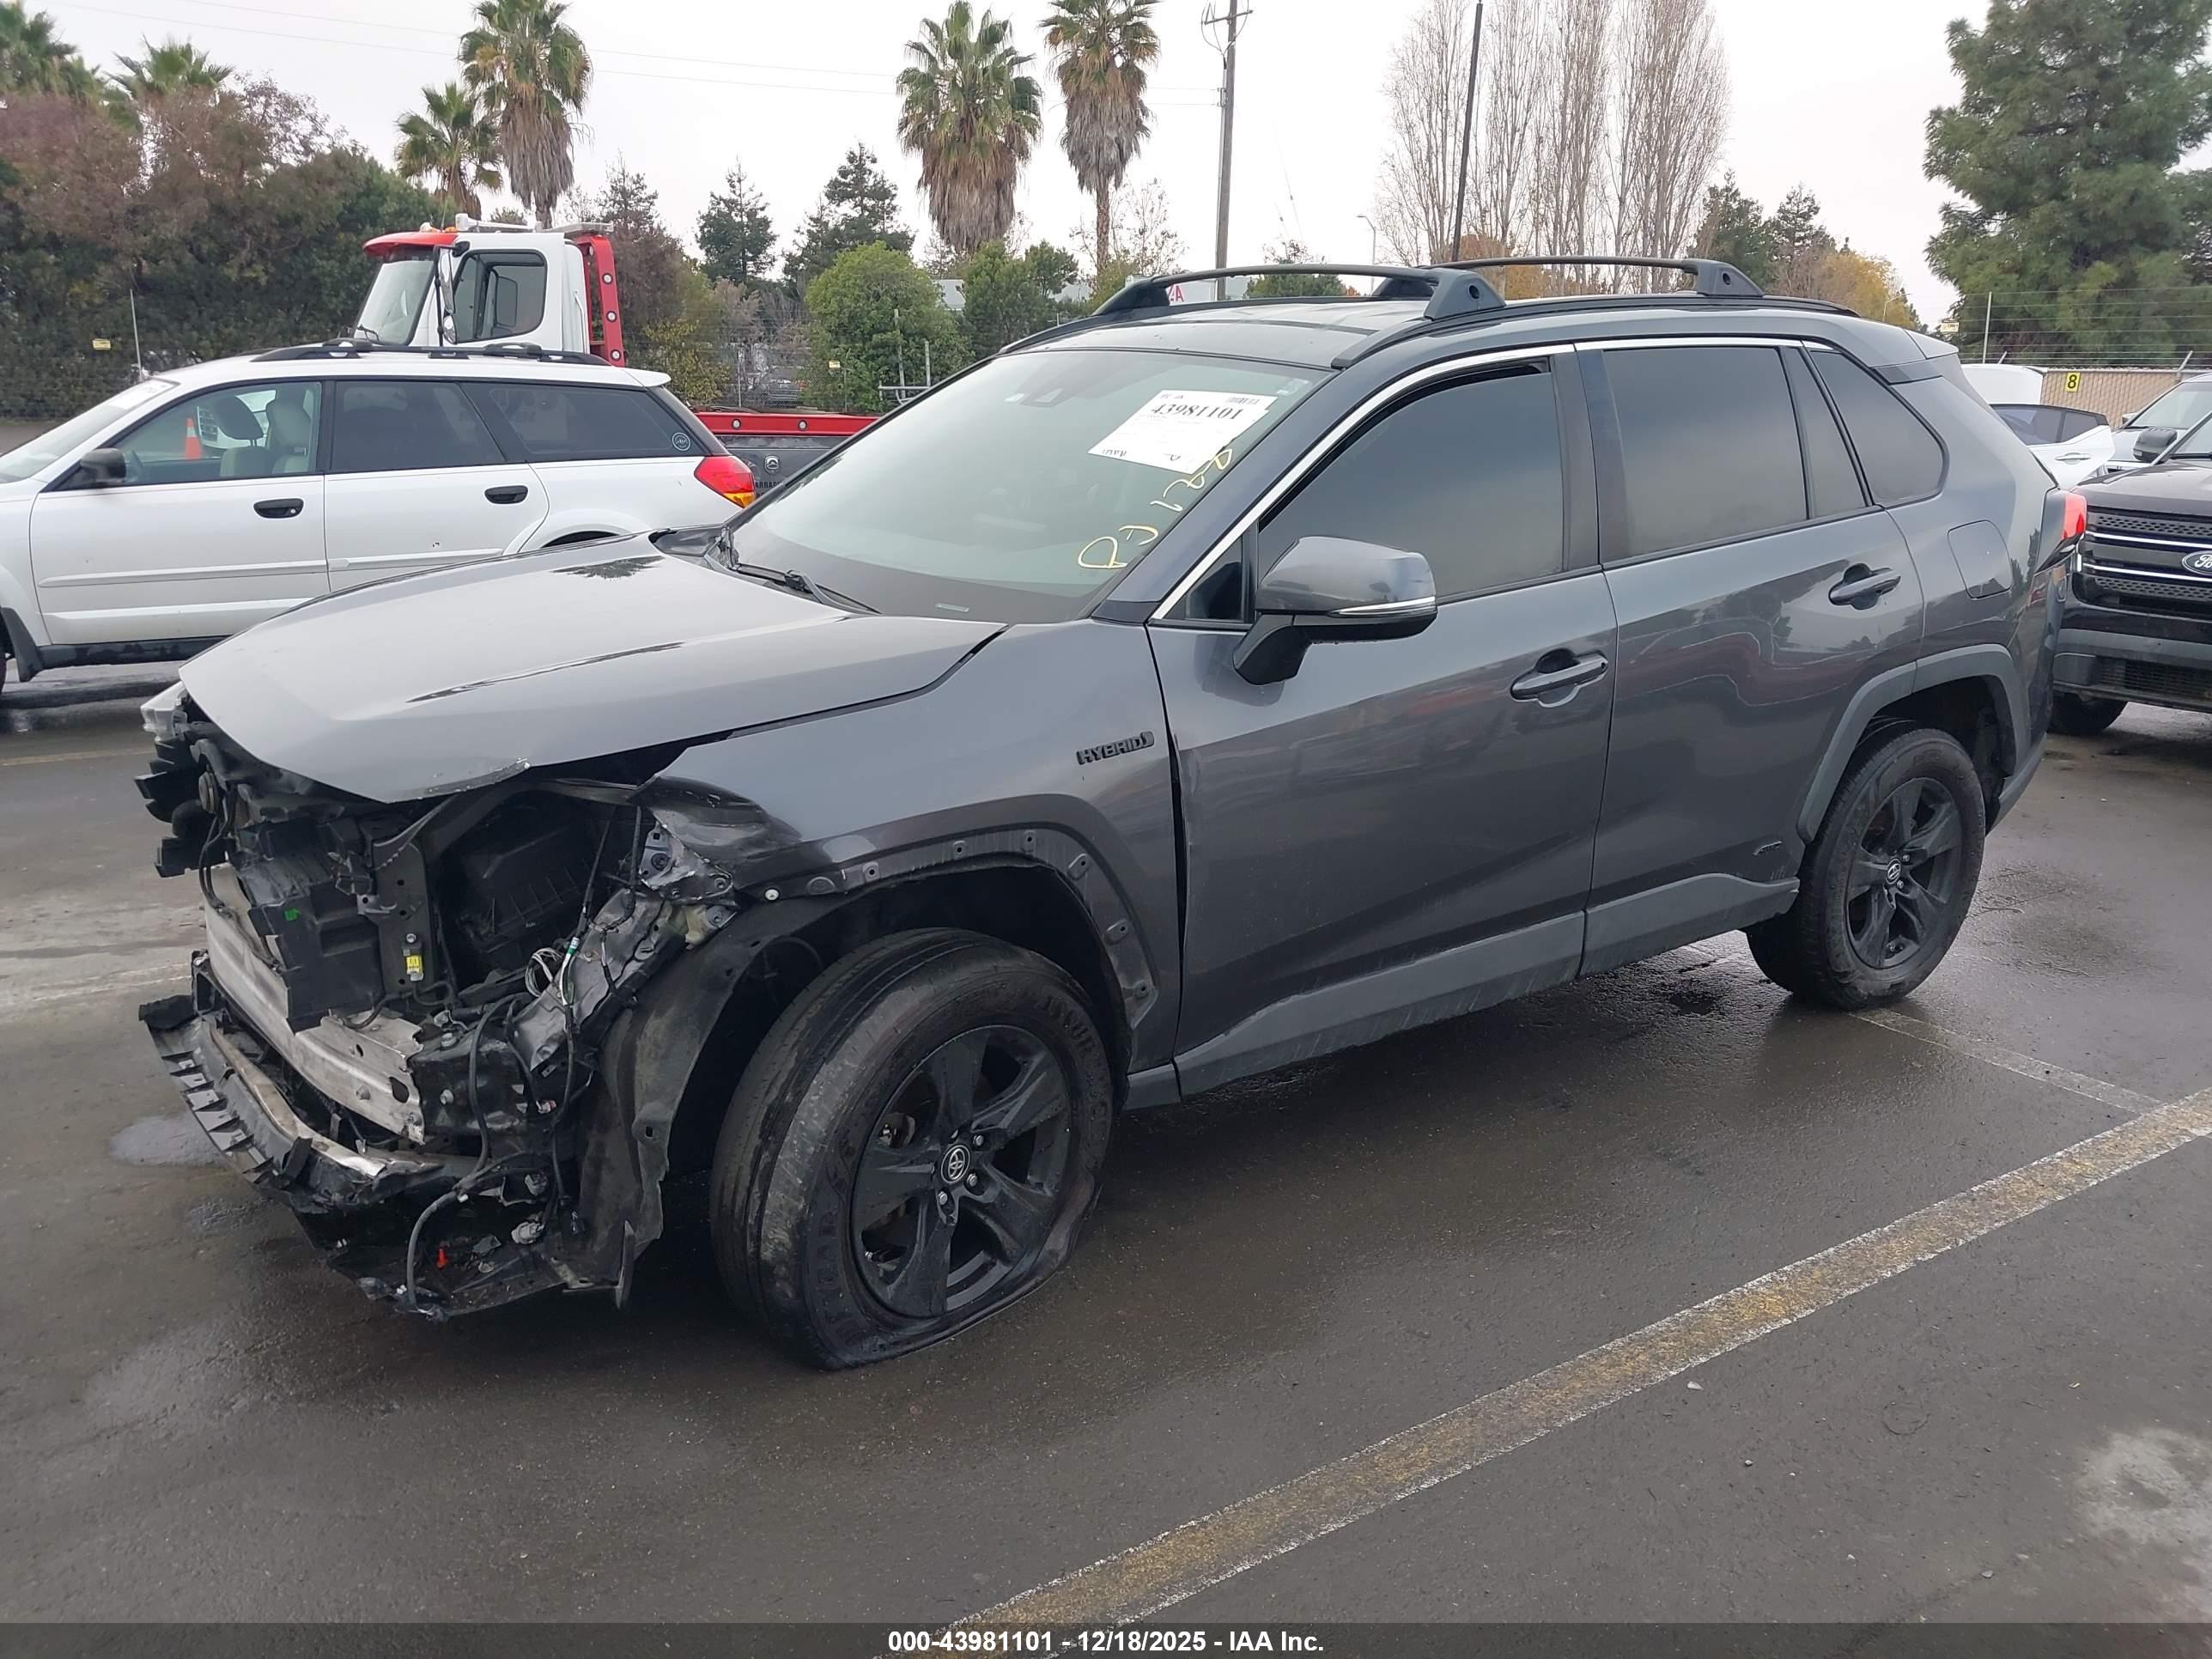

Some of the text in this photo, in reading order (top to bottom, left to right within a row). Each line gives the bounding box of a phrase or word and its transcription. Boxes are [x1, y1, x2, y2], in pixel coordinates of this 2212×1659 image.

[2068, 374, 2077, 389] 8
[1151, 404, 1244, 420] 43981101
[1076, 736, 1145, 765] HYBRID
